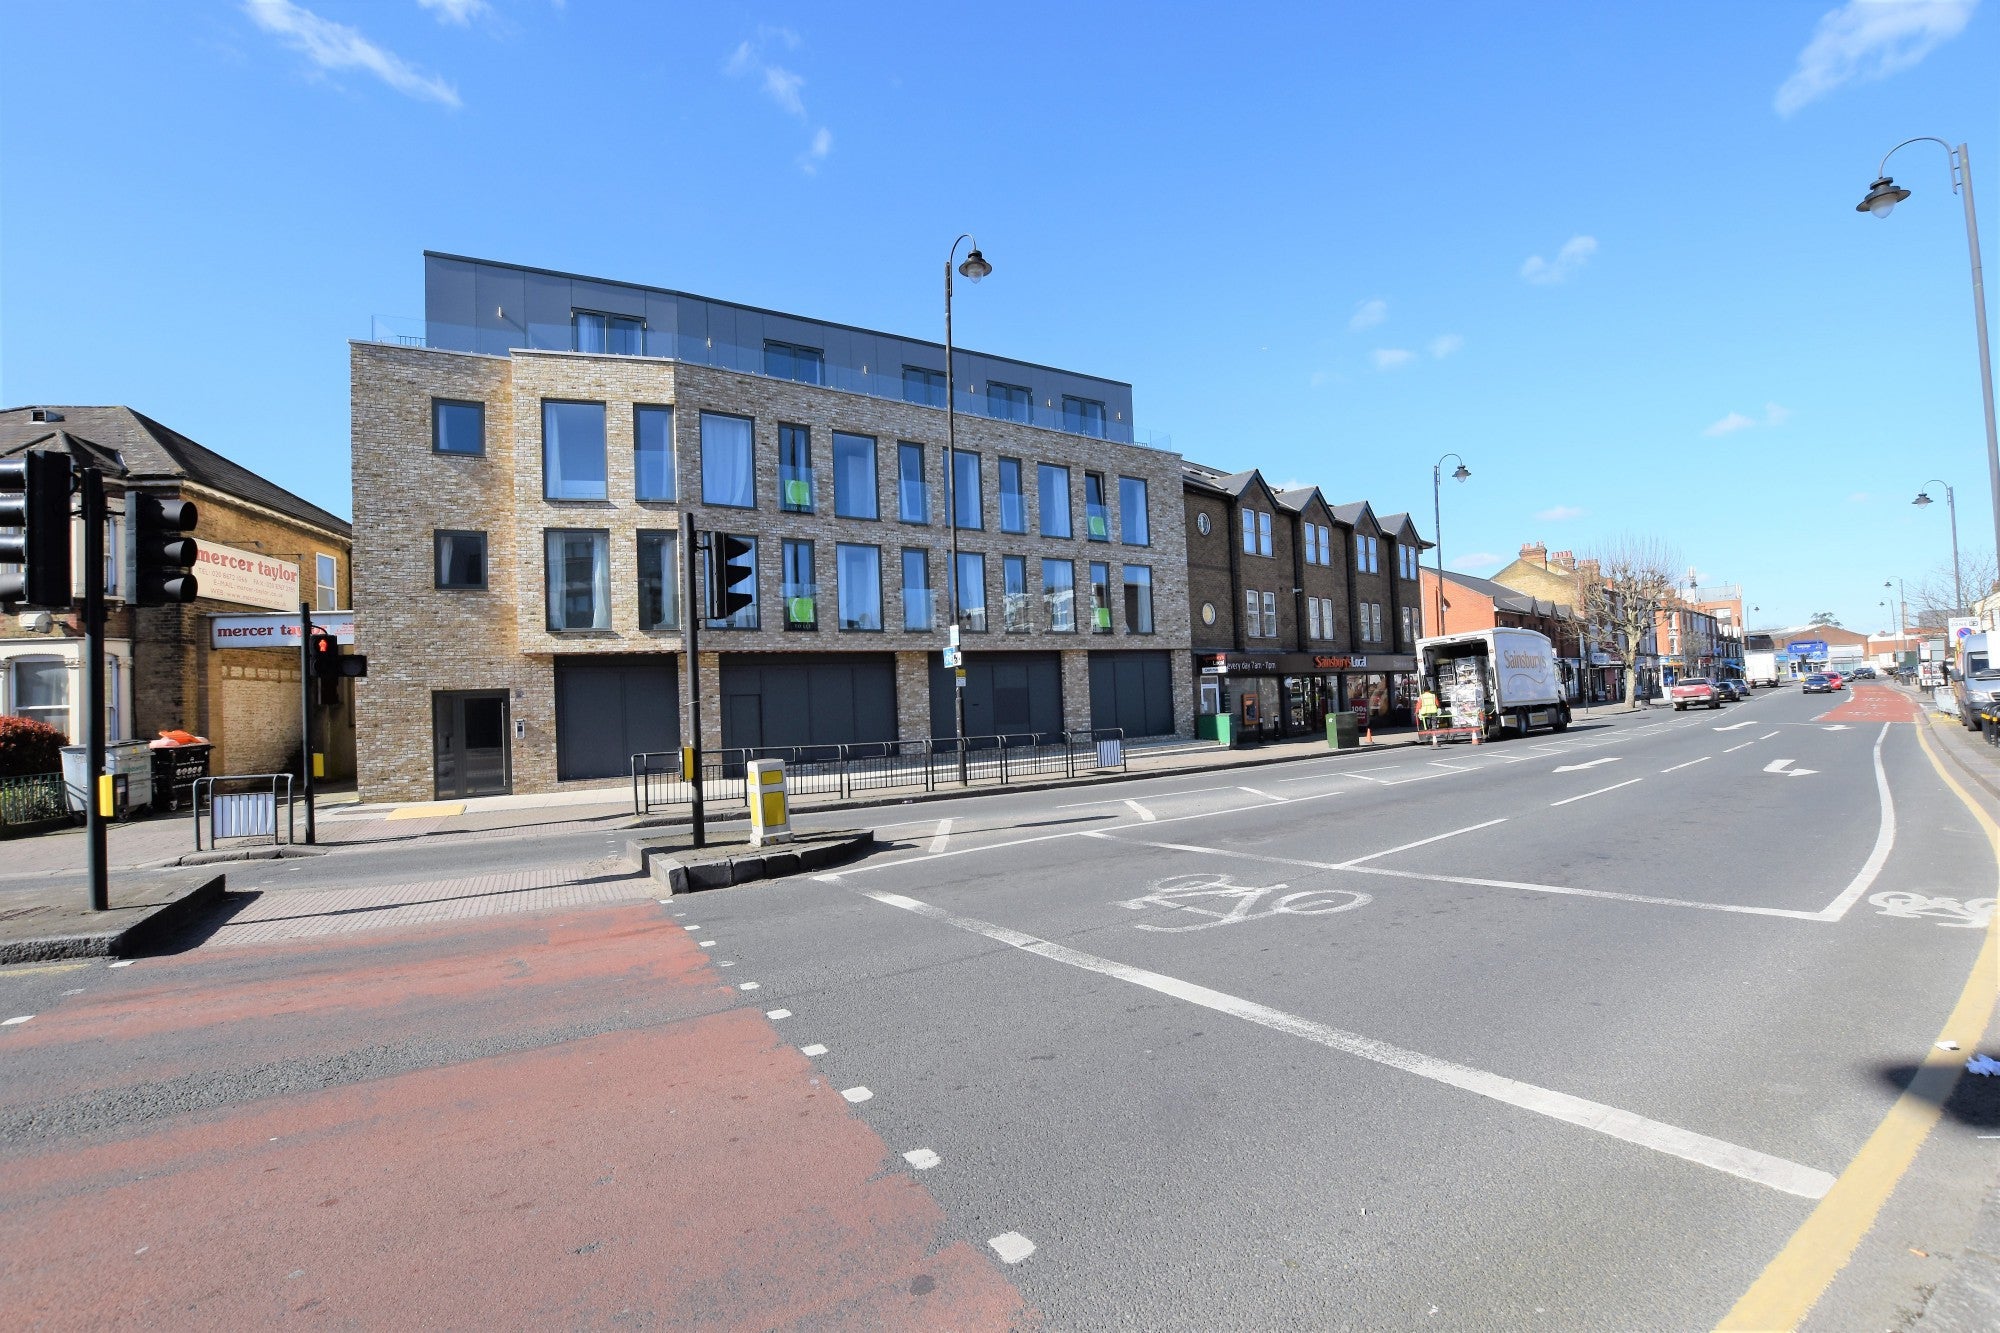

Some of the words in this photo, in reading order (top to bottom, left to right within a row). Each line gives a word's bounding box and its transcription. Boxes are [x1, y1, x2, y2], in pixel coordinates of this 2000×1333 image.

[196, 549, 254, 572] mercer
[258, 561, 298, 582] taylor
[217, 625, 274, 637] mercer
[1227, 663, 1241, 671] every
[1241, 662, 1250, 670] day
[1315, 656, 1351, 669] Sainsbury's
[1351, 656, 1367, 668] Local
[1503, 649, 1547, 672] Sainsbury's
[1351, 705, 1367, 713] 100s
